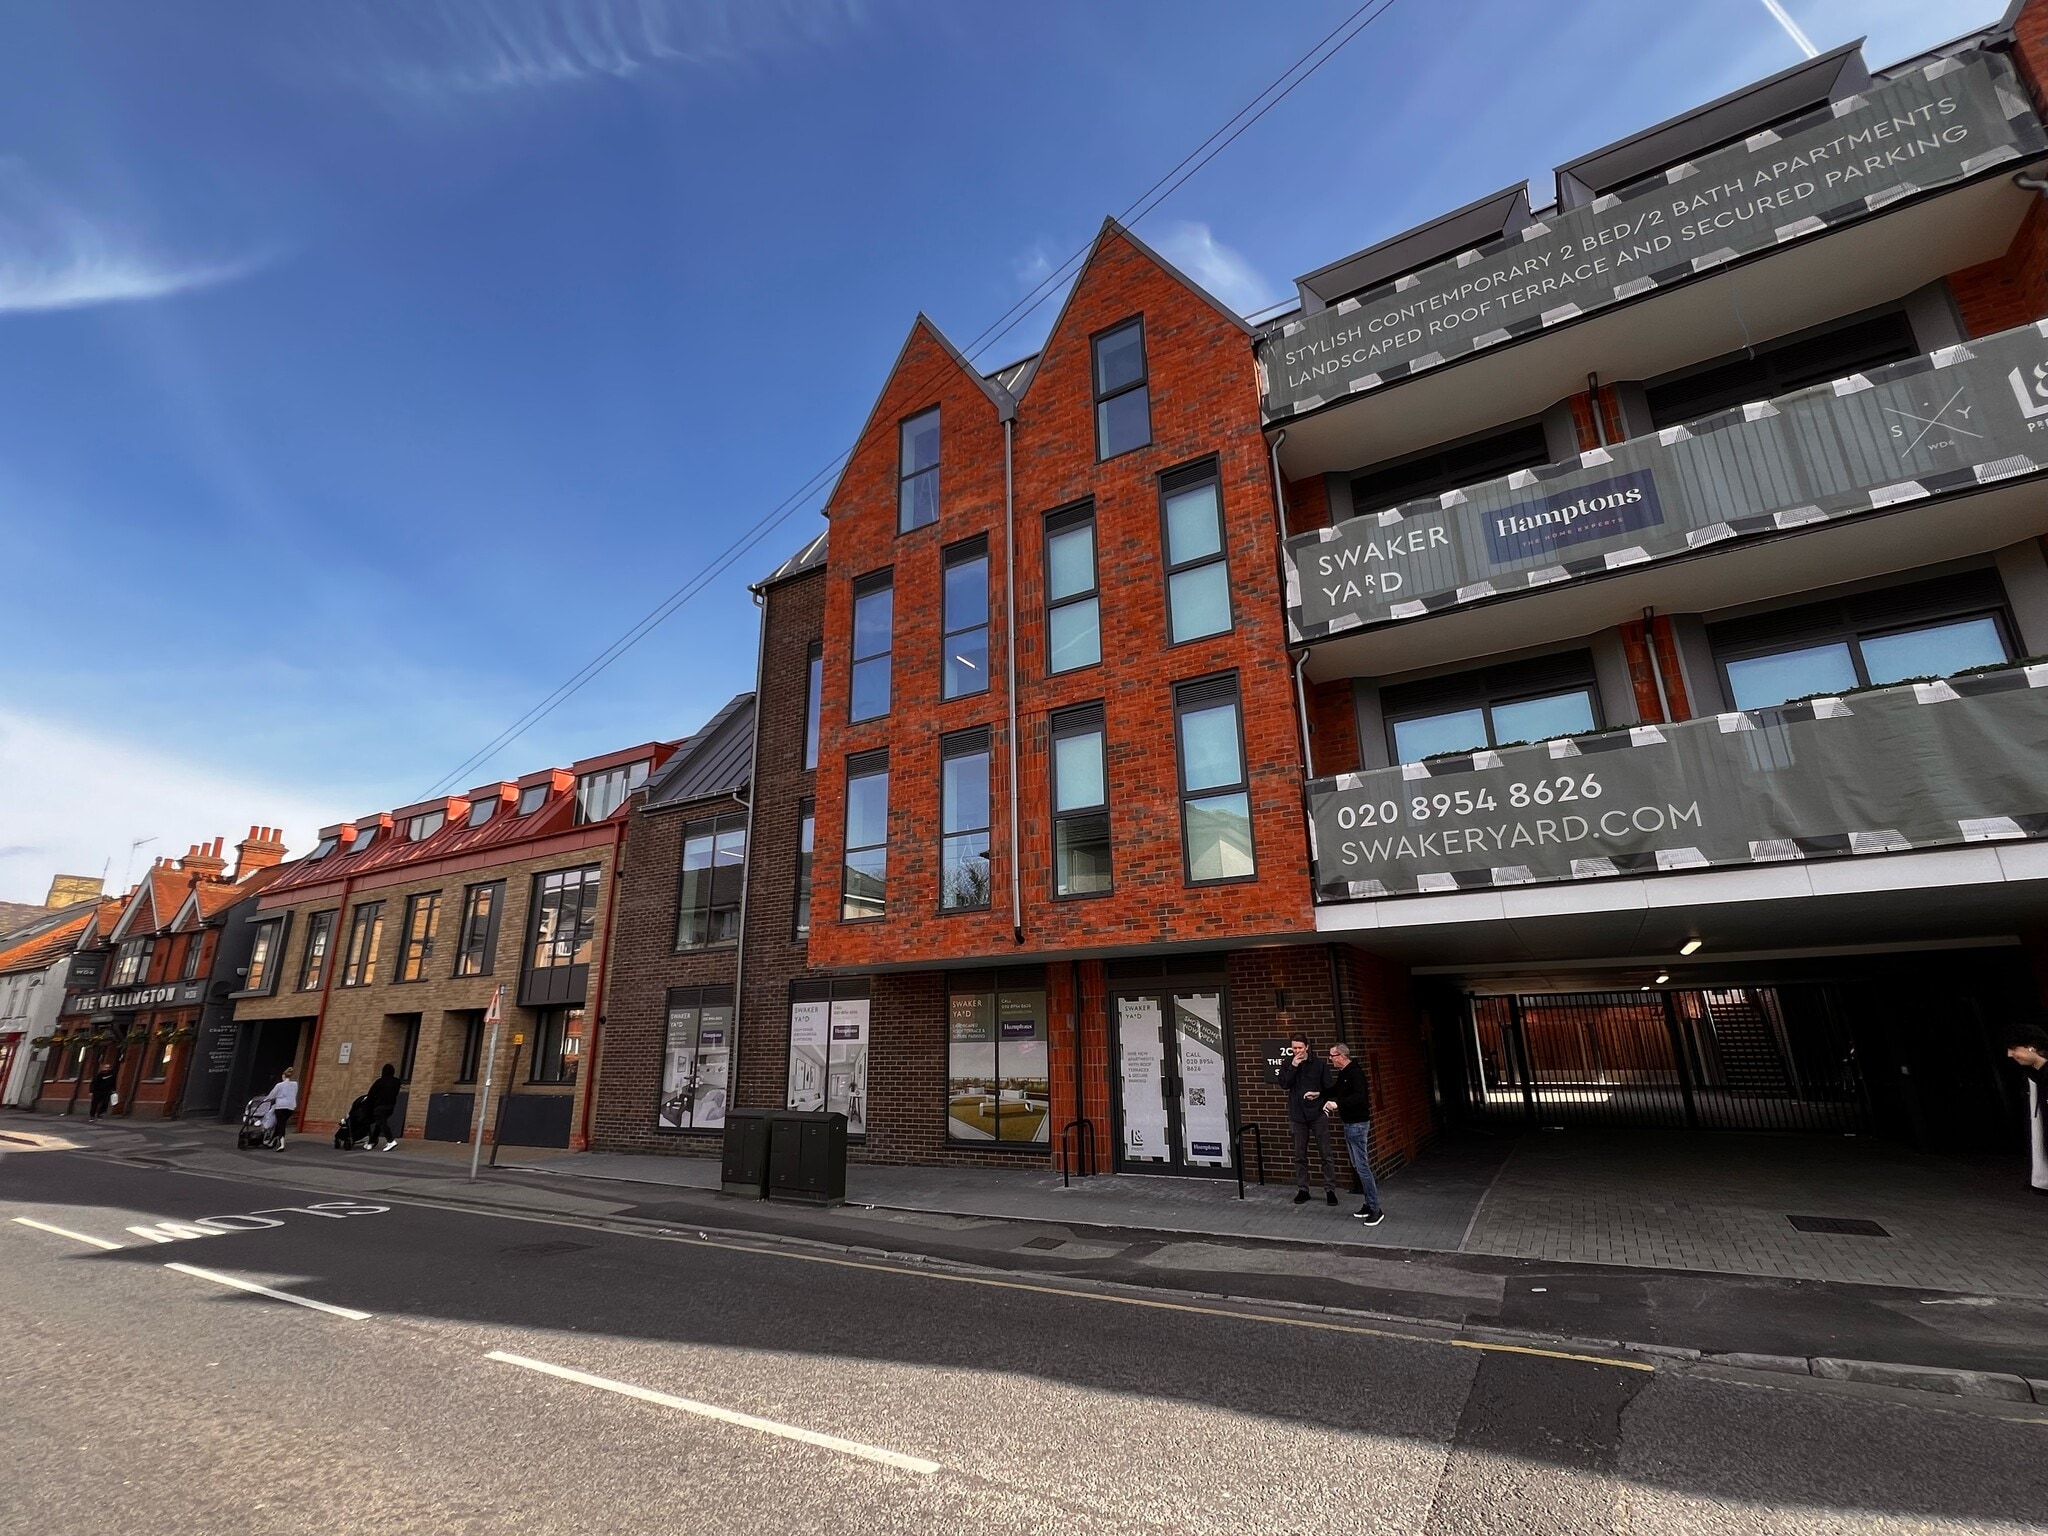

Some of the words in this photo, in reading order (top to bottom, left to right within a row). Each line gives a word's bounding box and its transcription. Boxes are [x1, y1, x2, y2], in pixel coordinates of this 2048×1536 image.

[1285, 326, 1362, 365] STYLISH
[1368, 251, 1552, 333] CONTEMPORARY
[1560, 244, 1575, 261] 2
[1582, 210, 1664, 252] BED/2
[1672, 178, 1744, 217] BATH
[1753, 97, 1958, 187] APARTMENTS
[1289, 329, 1422, 388] LANDSCAPED
[1429, 303, 1492, 336] ROOF
[1496, 258, 1610, 310] TERRACE
[1616, 235, 1672, 266] AND
[1682, 182, 1815, 241] SECURED
[1827, 124, 1968, 188] PARKING
[1496, 487, 1642, 538] Hamptons
[1522, 539, 1540, 547] THE
[1545, 530, 1572, 540] HOME
[1577, 517, 1624, 532] EXPERTS
[1318, 526, 1449, 576] SWAKER
[1322, 571, 1403, 606] YARD
[1337, 801, 1398, 830] 020
[1411, 788, 1497, 821] 8954
[1509, 773, 1602, 808] 8626
[1341, 801, 1702, 865] SWAKERYARD.COM
[75, 997, 96, 1011] THE
[100, 987, 176, 1008] WELLINGTON
[794, 1006, 819, 1014] SWAKER
[952, 1000, 982, 1008] SWAKER
[1124, 1004, 1151, 1012] SWAKER
[1199, 1032, 1215, 1044] OPEN
[1202, 1026, 1219, 1040] HOME
[125, 1201, 391, 1244] SLOW
